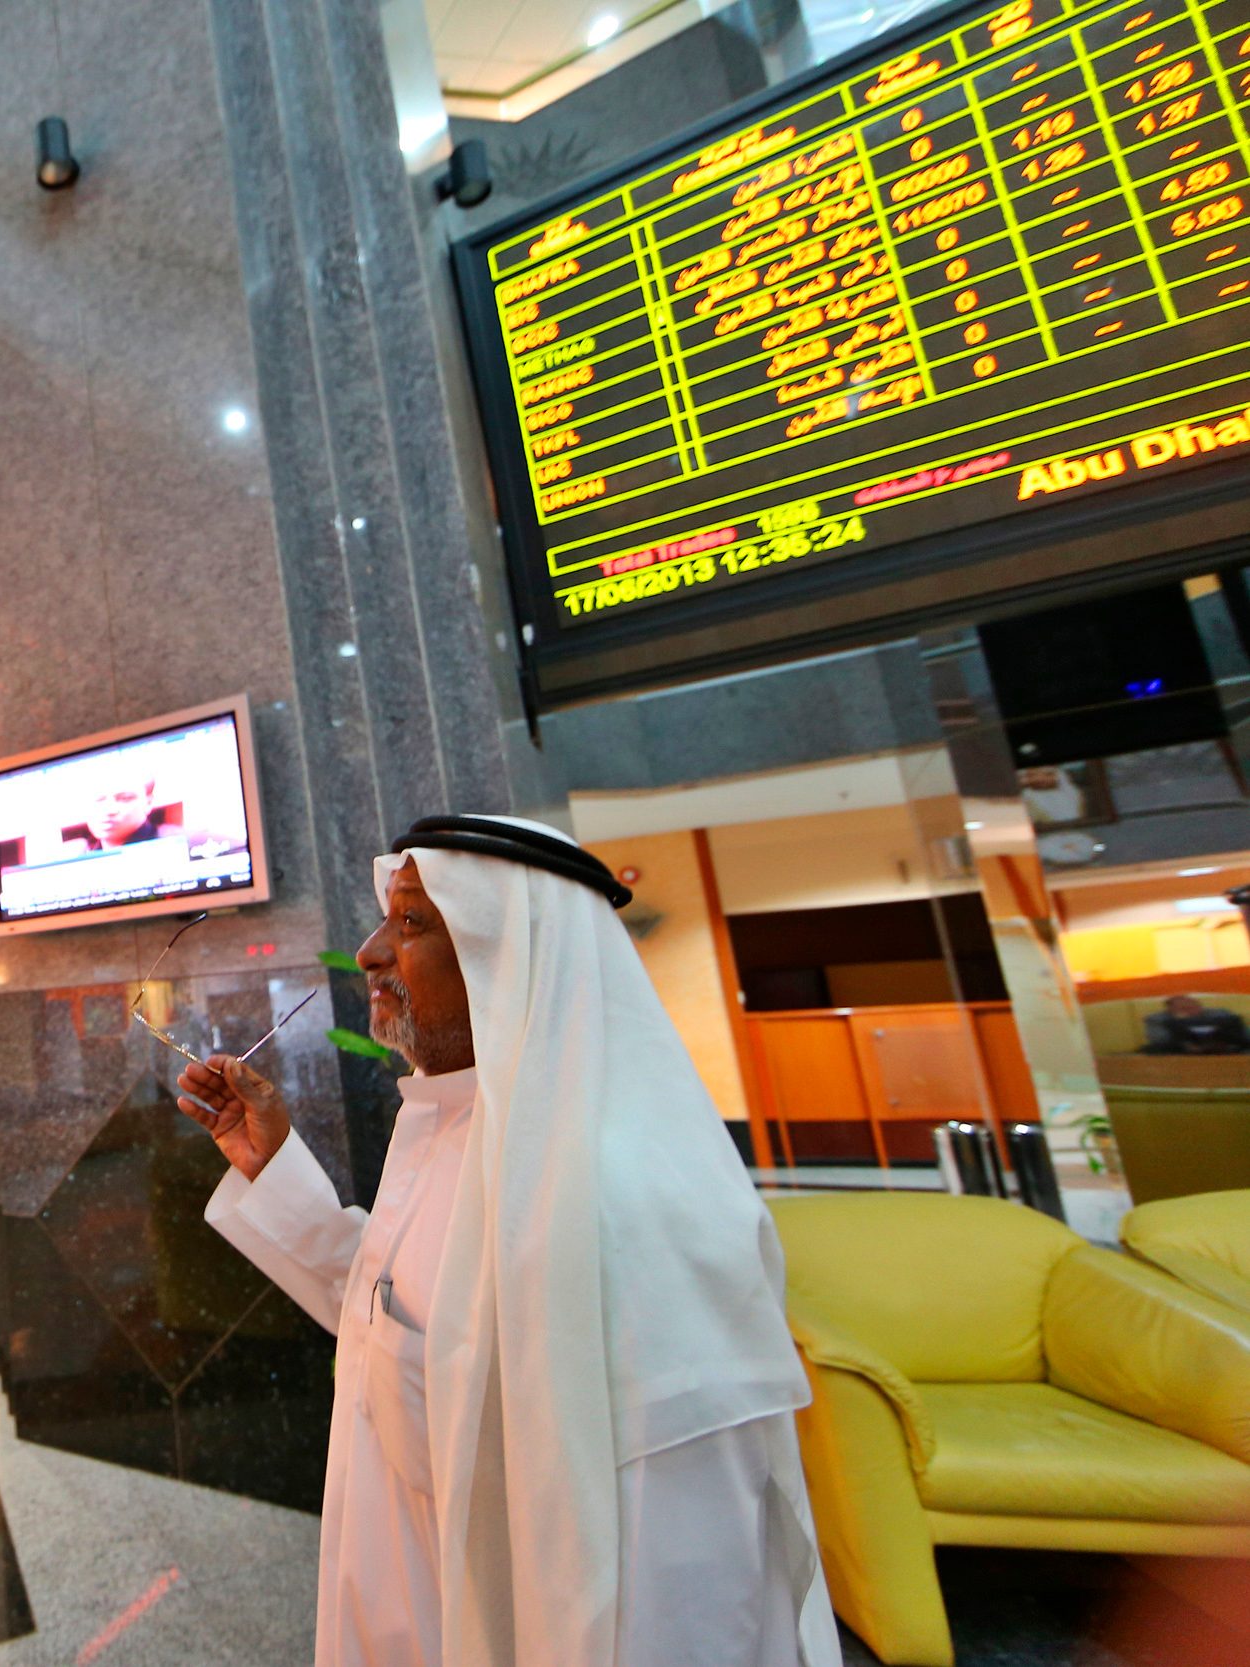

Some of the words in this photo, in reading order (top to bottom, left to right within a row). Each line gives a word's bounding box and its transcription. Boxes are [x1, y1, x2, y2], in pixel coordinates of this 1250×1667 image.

[899, 106, 924, 132] 0
[909, 135, 933, 161] 0
[1169, 194, 1245, 237] 5.00
[935, 226, 960, 251] 0
[944, 257, 969, 282] 0
[953, 288, 979, 313] 0
[962, 321, 989, 345] 0
[972, 353, 998, 378] 0
[1017, 449, 1128, 501] Abu
